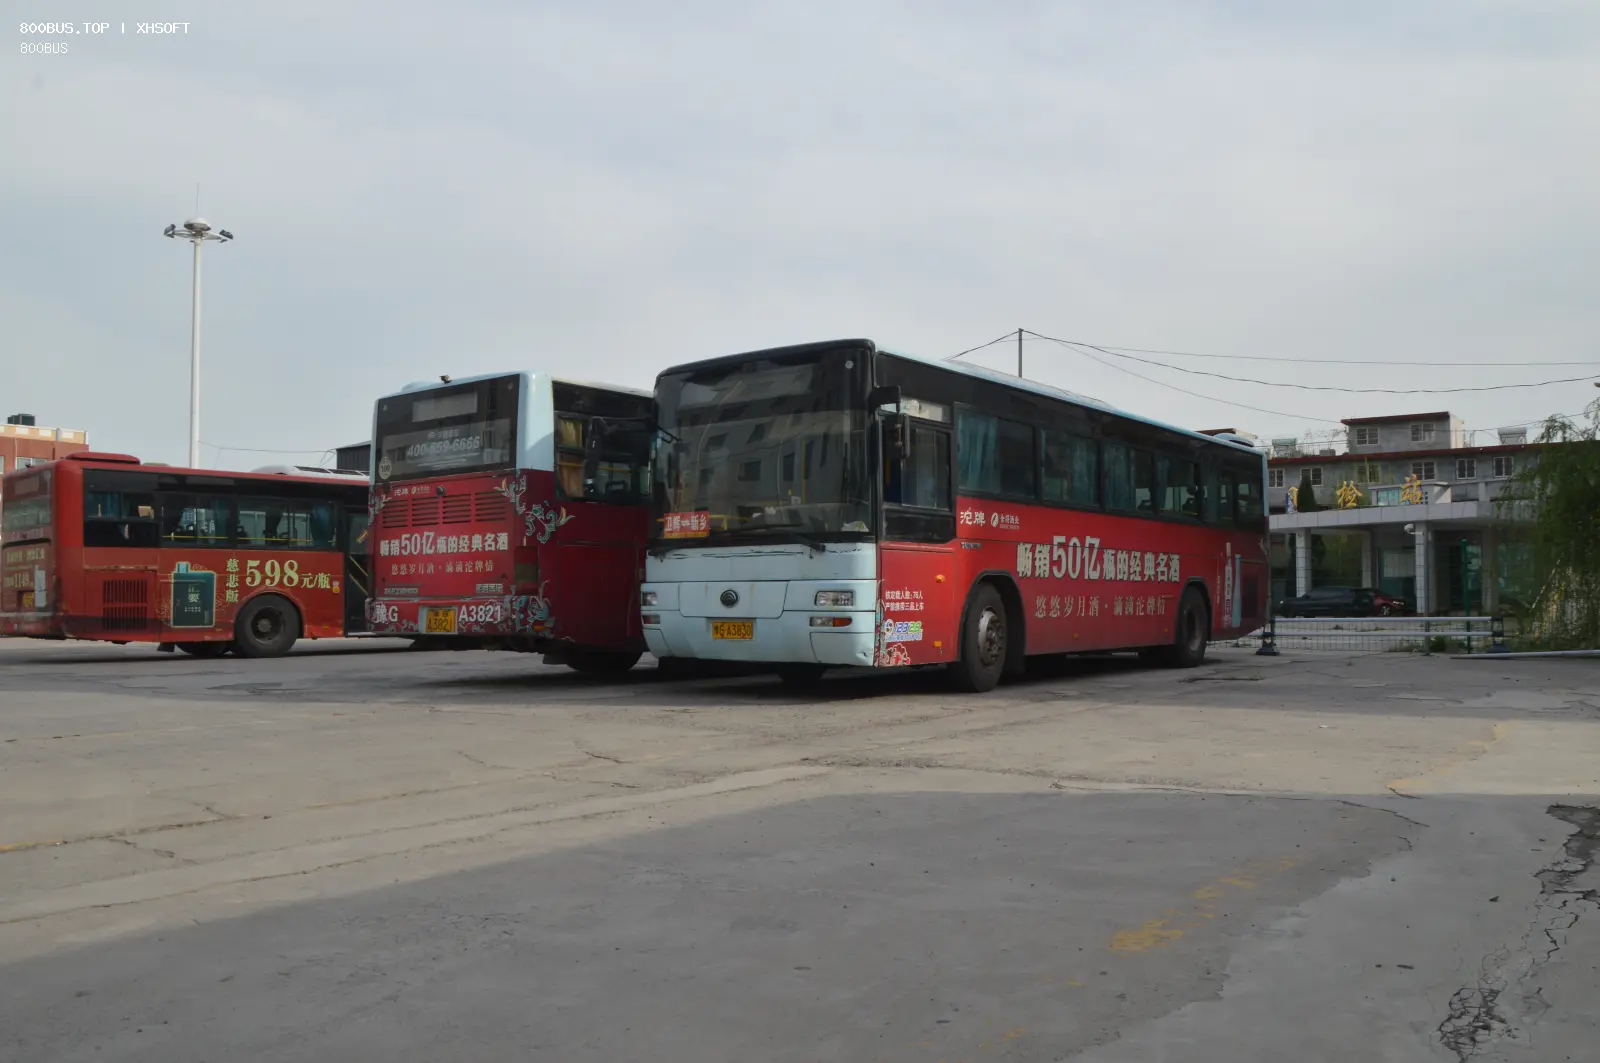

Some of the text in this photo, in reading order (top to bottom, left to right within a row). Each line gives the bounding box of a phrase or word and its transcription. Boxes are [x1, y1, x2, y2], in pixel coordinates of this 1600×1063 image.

[1016, 535, 1180, 582] 畅销50亿瓶的经典名酒
[458, 604, 501, 622] A3821
